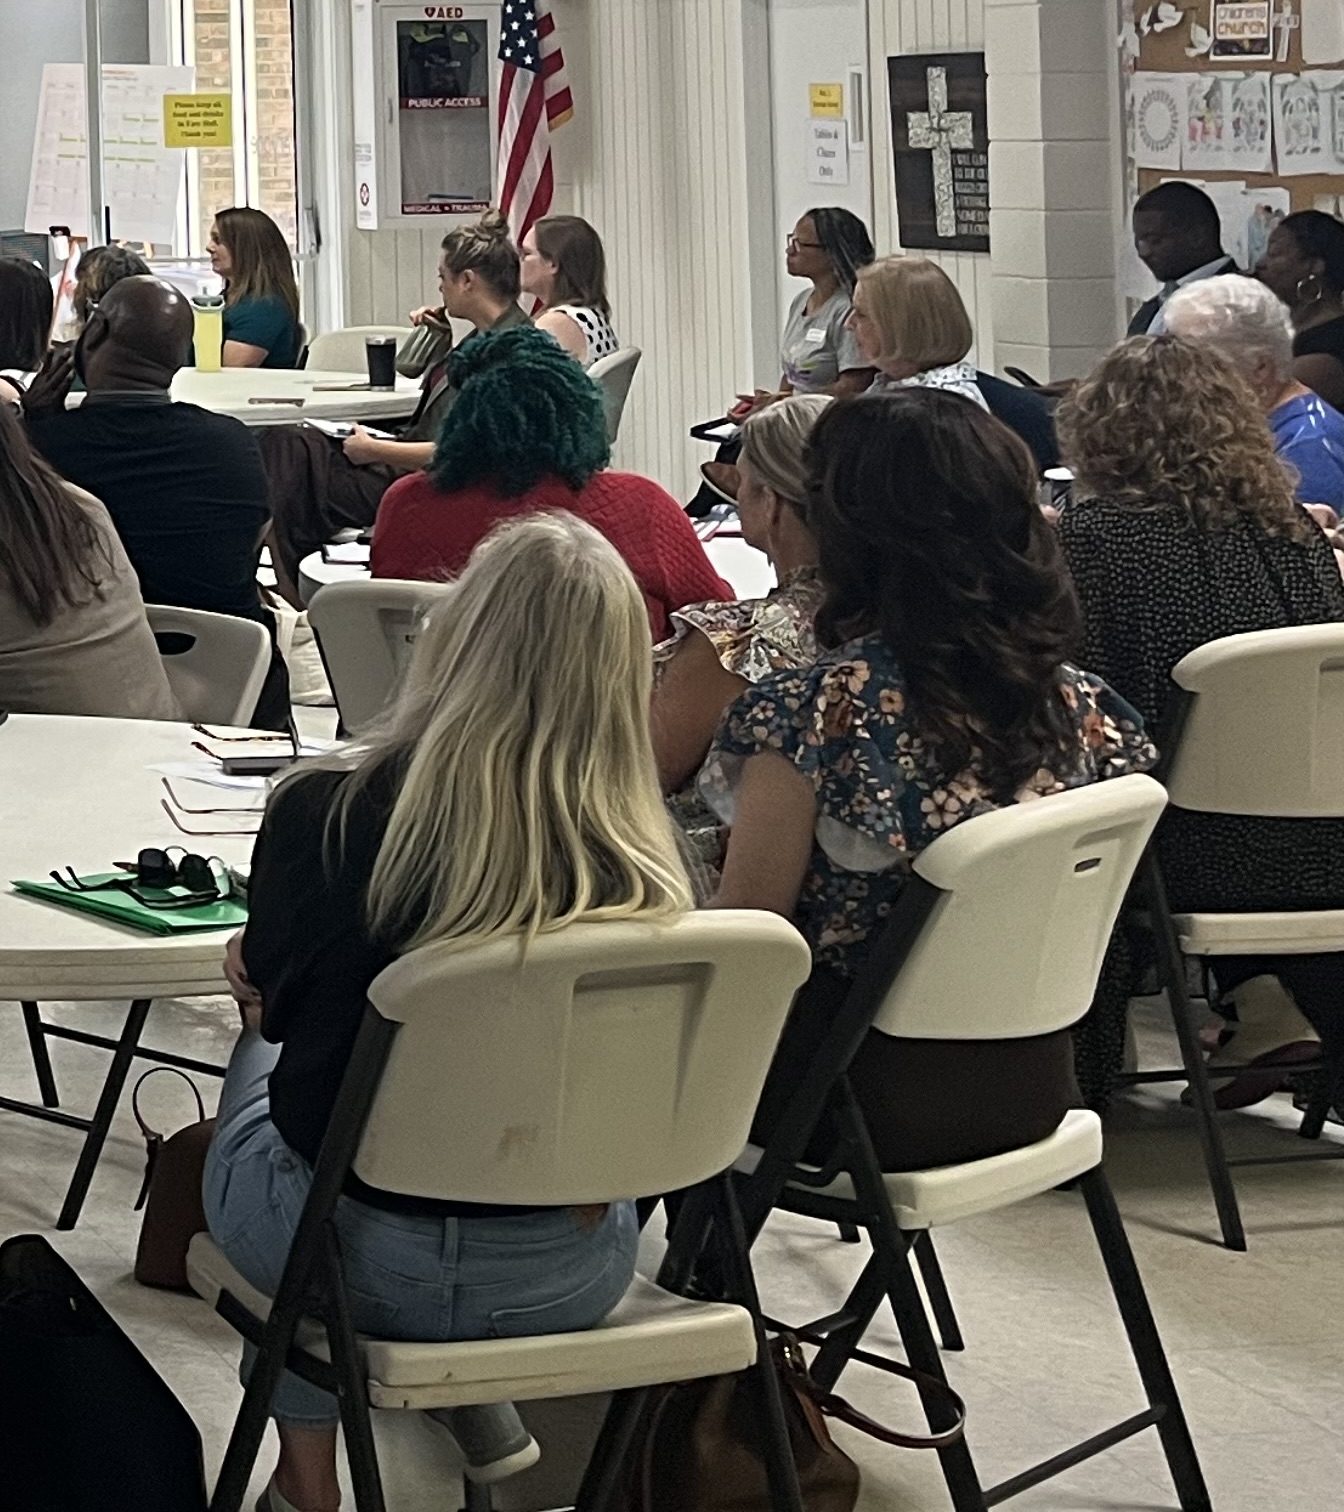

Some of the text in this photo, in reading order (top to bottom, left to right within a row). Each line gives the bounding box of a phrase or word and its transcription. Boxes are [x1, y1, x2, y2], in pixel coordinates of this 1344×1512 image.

[436, 7, 463, 18] AED
[408, 97, 482, 109] PUBLIC ACCESS
